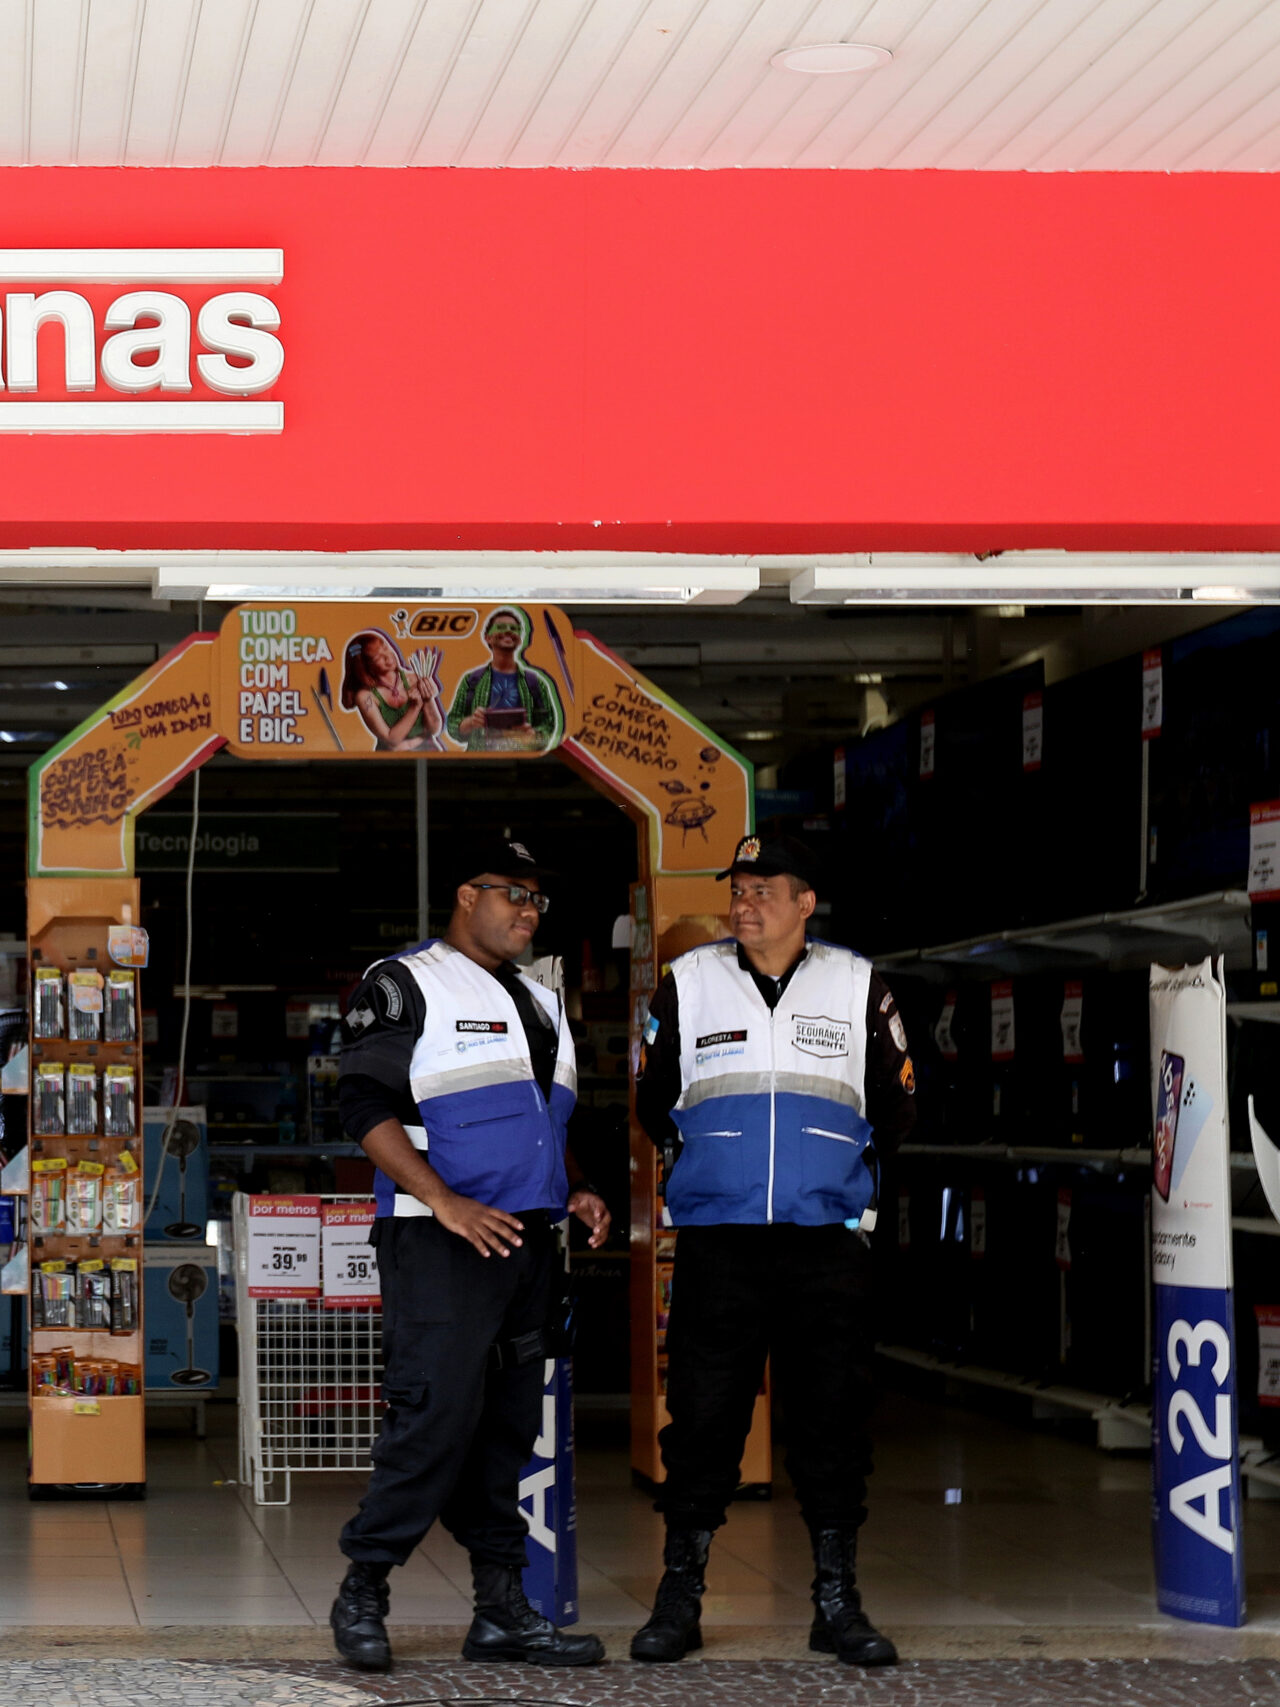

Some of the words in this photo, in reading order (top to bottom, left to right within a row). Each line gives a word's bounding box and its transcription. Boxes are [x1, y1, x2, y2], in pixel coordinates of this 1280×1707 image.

[239, 609, 296, 635] TUDO
[239, 636, 333, 663] COMEÇA
[239, 663, 288, 689] COM
[239, 691, 307, 716] PAPEL
[615, 683, 663, 711] TUDO
[239, 718, 254, 743] E
[259, 718, 304, 743] BIC.
[582, 711, 623, 734] COM
[627, 725, 668, 749] UMA
[136, 830, 260, 858] Tecnologia
[458, 1022, 491, 1031] SANTIAGO
[796, 1024, 847, 1043] SEGURANÇA
[796, 1036, 846, 1050] PRESENTE
[253, 1206, 274, 1216] por
[276, 1206, 318, 1215] menos
[326, 1214, 348, 1225] por
[1166, 1318, 1235, 1555] A23
